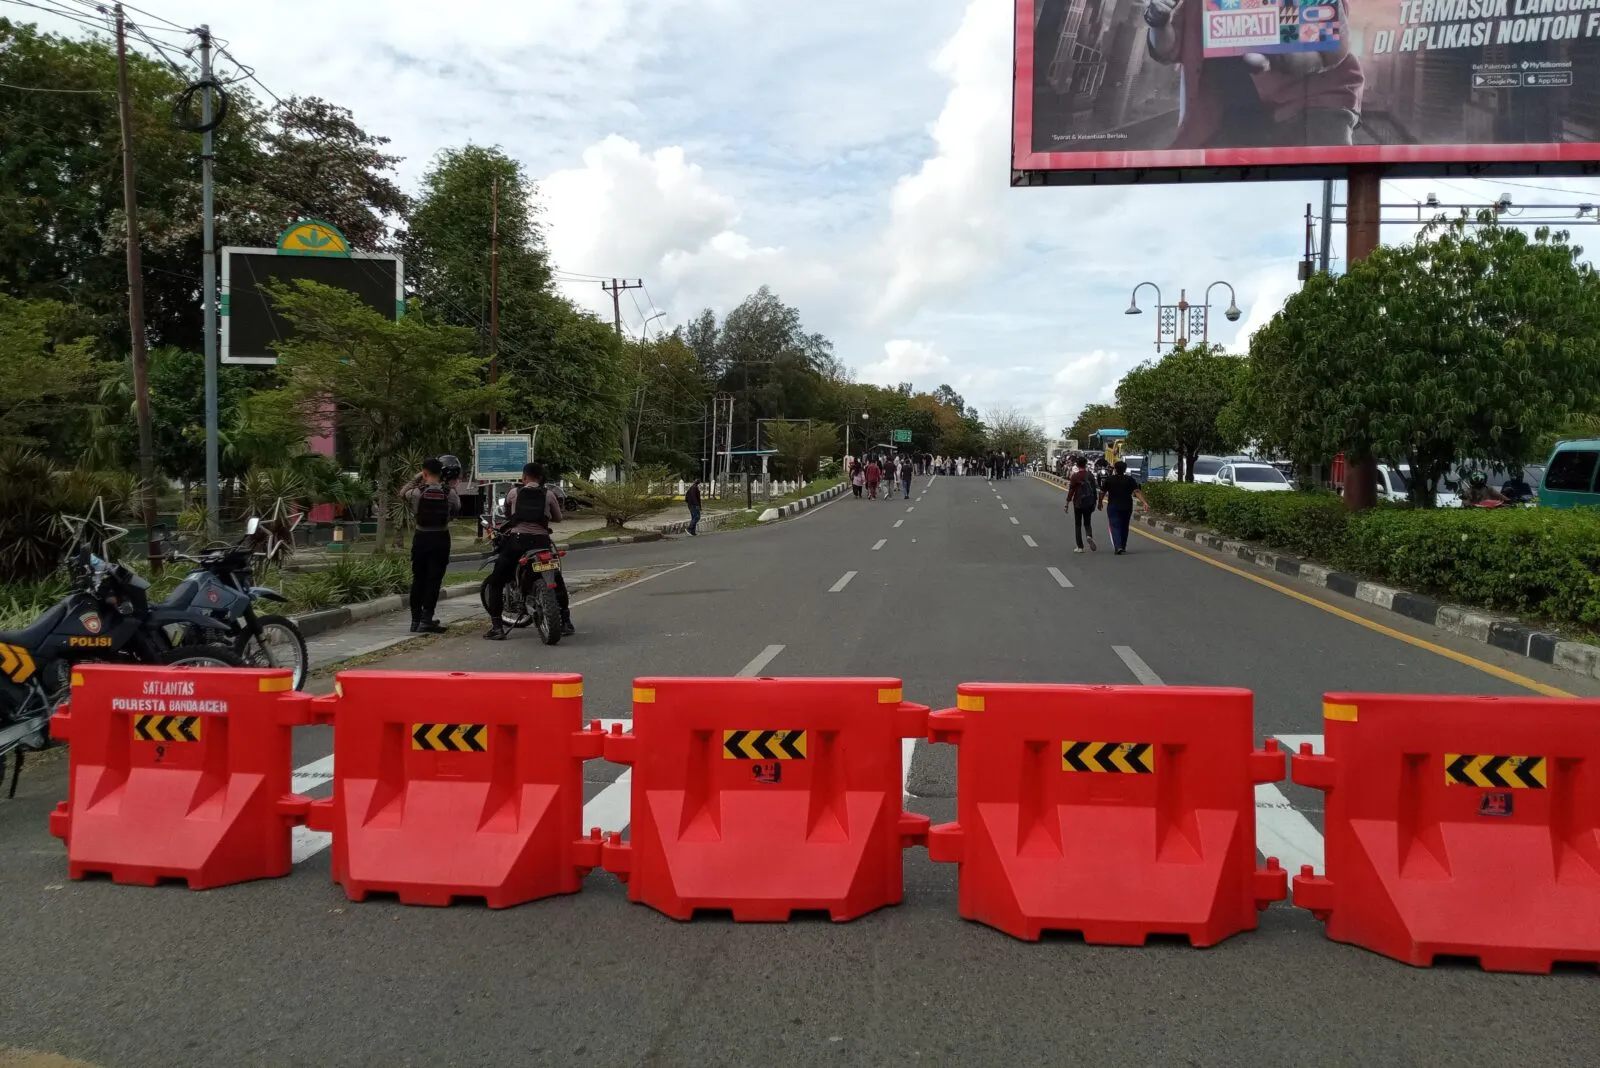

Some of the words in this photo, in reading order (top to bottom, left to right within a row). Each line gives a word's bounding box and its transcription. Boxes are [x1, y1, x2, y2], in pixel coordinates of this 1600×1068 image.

[1400, 0, 1508, 25] TERMASUK
[1212, 12, 1275, 38] SIMPATI
[1374, 30, 1396, 54] DI
[1399, 21, 1493, 52] APLIKASI
[1497, 14, 1582, 44] NONTON
[70, 637, 112, 647] POLISI
[143, 681, 195, 696] SATLANTAS
[112, 699, 166, 712] POLRESTA
